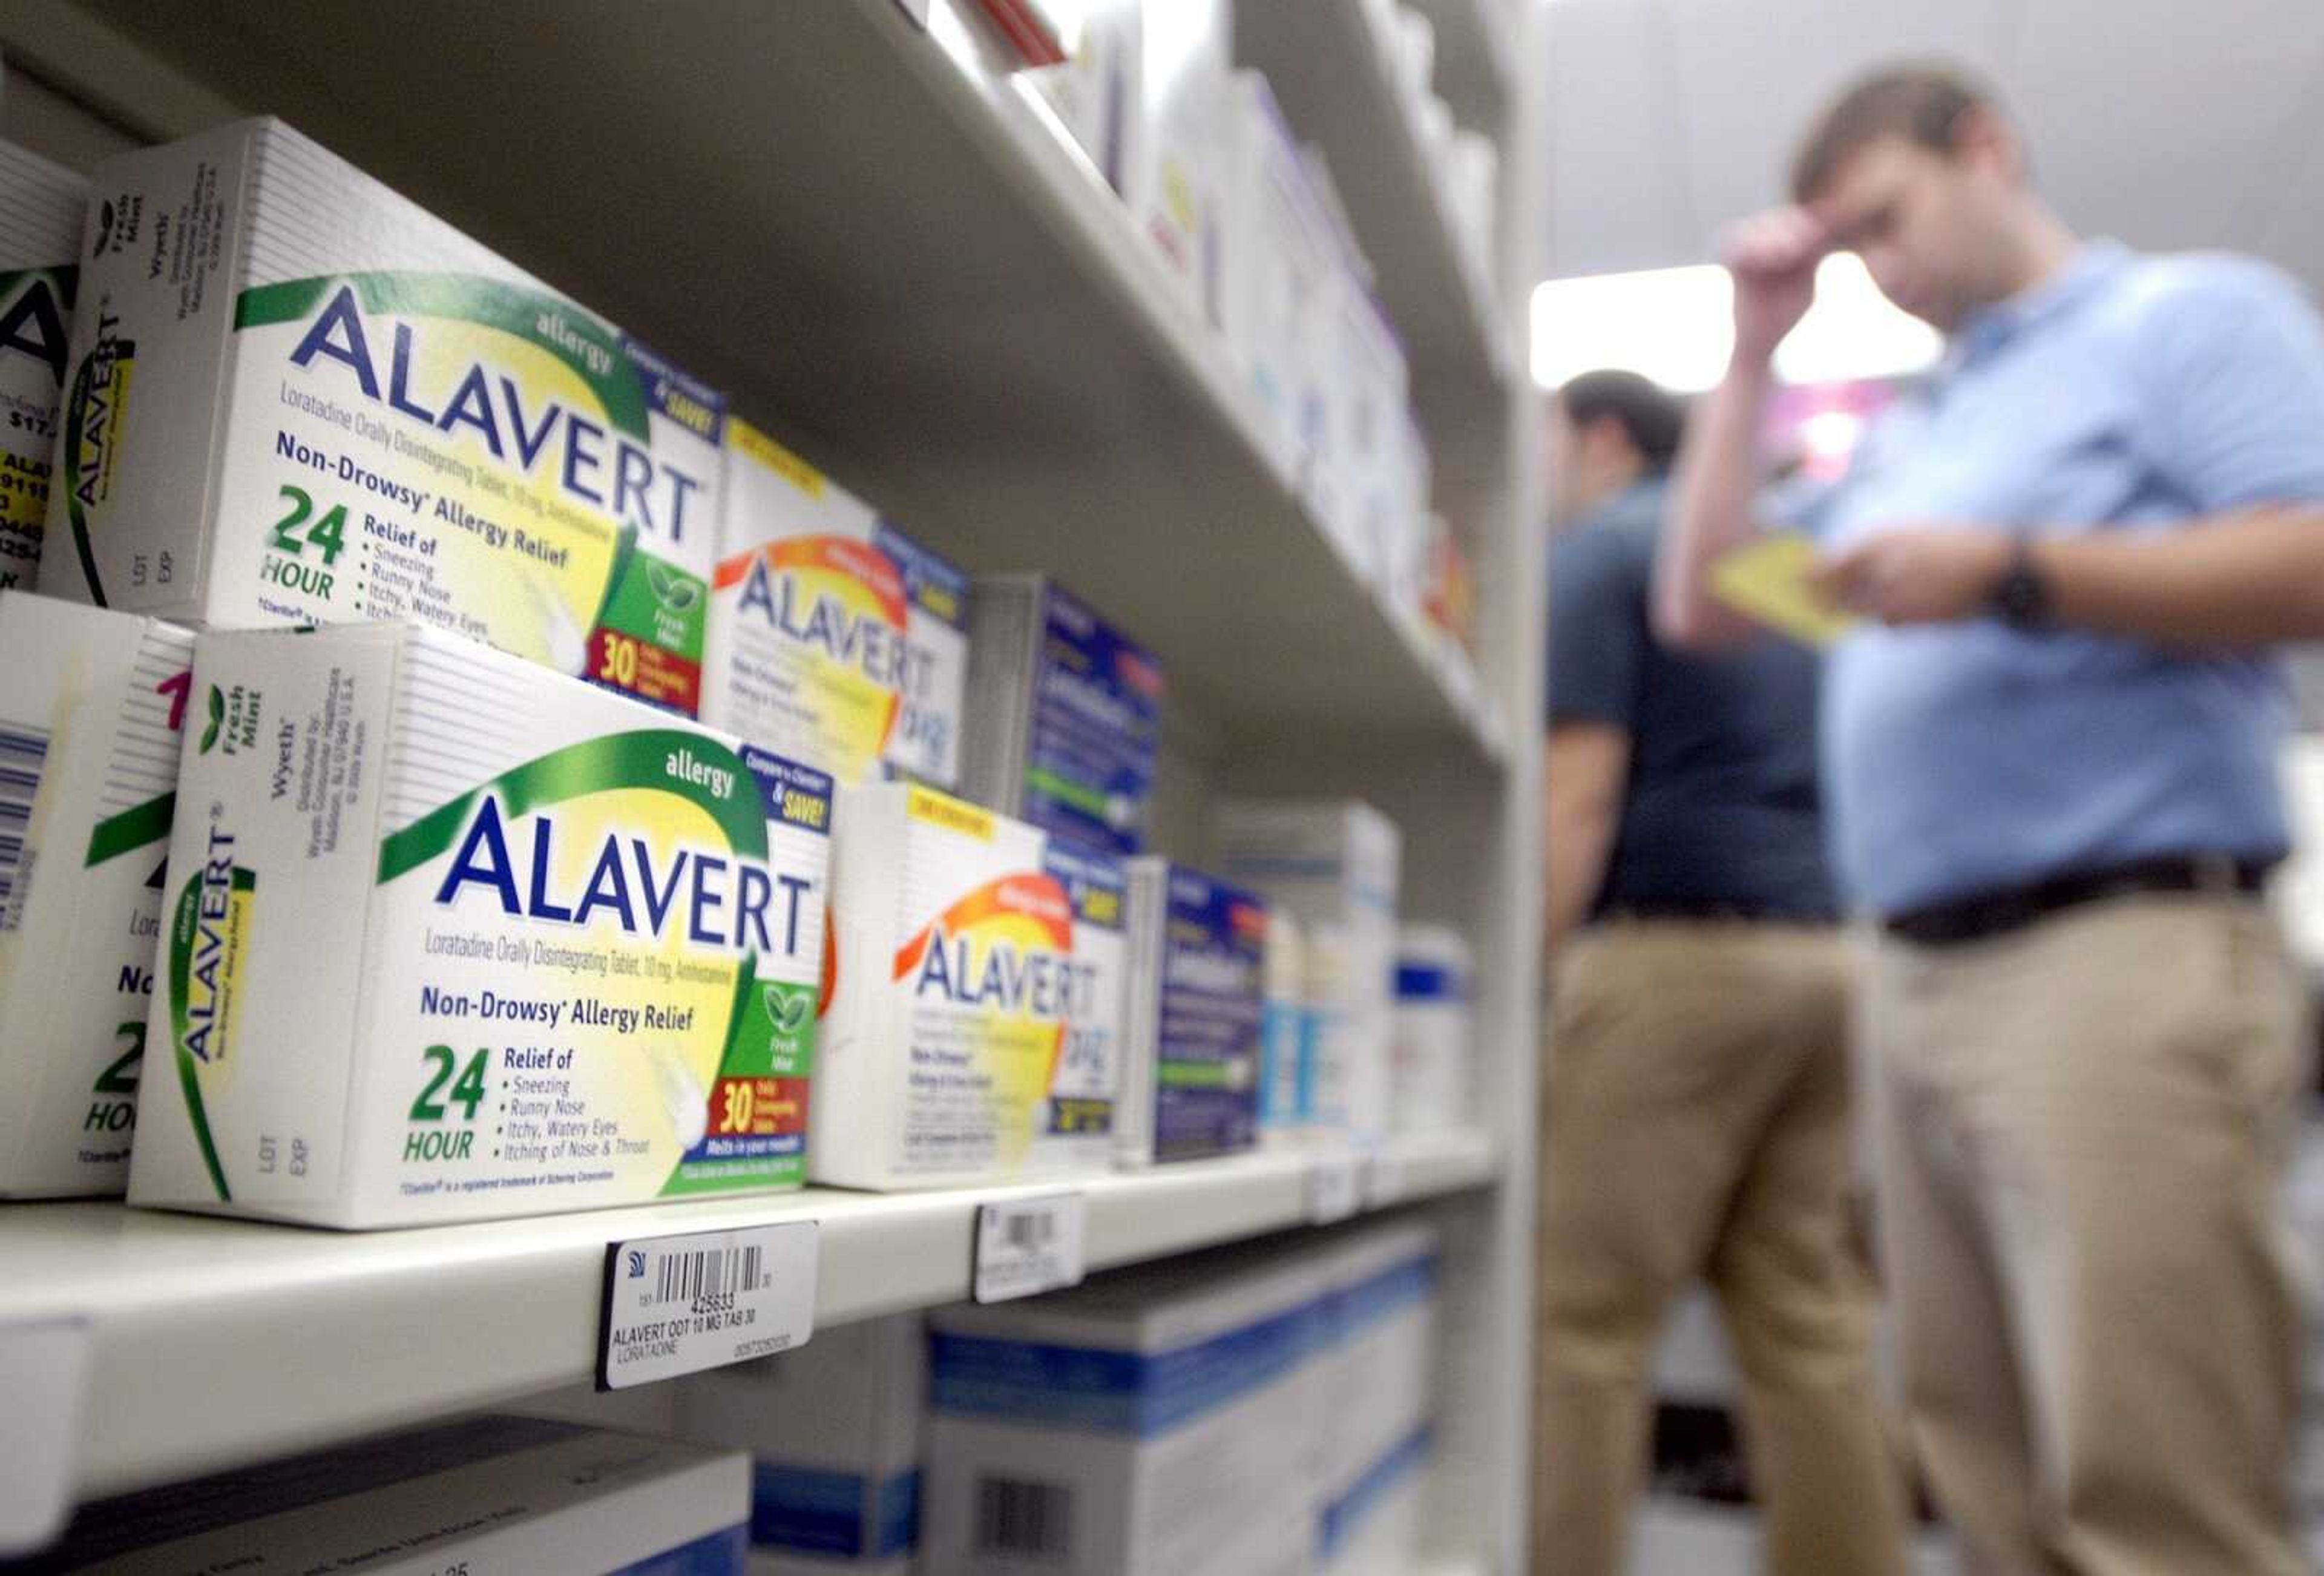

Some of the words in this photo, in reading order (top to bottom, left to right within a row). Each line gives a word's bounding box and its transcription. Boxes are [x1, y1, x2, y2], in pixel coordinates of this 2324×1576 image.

[127, 193, 144, 243] Mint
[536, 313, 613, 375] allergy
[280, 381, 352, 430] Loratadine
[355, 413, 392, 451] Orally
[395, 430, 473, 485] Disintegrating
[289, 284, 697, 542] ALAVERT
[274, 484, 348, 565] 24
[364, 513, 418, 549] Relief
[419, 538, 437, 556] of
[434, 497, 508, 548] Allergy
[513, 529, 569, 569] Relief
[260, 554, 335, 600] HOUR
[371, 561, 415, 592] Runny
[419, 579, 451, 603] Nose
[373, 543, 435, 581] Sneezing
[412, 598, 457, 626] Watery
[459, 612, 490, 634] Eyes
[738, 558, 936, 700] ALAVERT
[600, 633, 636, 685] 30
[223, 685, 244, 756] Fresh
[241, 691, 261, 749] Mint
[666, 748, 734, 799] allergy
[782, 789, 827, 828] SAVE!
[434, 795, 812, 955] ALAVERT
[425, 927, 494, 961] Loratadine
[497, 935, 531, 970] Orally
[533, 939, 608, 978] Disintegrating
[916, 927, 1097, 1016] ALAVERT
[571, 999, 640, 1034] Allergy
[643, 1004, 695, 1031] Relief
[504, 1047, 554, 1069] Relief
[557, 1048, 574, 1070] of
[407, 1045, 490, 1122] 24
[513, 1075, 571, 1098] Sneezing
[84, 1102, 137, 1131] HO
[507, 1121, 542, 1140] Itchy,
[547, 1120, 589, 1138] Watery
[592, 1118, 618, 1138] Eyes
[510, 1098, 551, 1118] Runny
[555, 1099, 585, 1115] Nose
[719, 1081, 754, 1135] 30
[257, 1135, 277, 1174] LOT
[288, 1138, 307, 1177] EXP
[402, 1130, 474, 1163] HOUR
[504, 1143, 548, 1163] Itching
[551, 1140, 566, 1159] of
[569, 1140, 599, 1158] Nose
[616, 1138, 651, 1154] Throat
[612, 1322, 666, 1346] ALAVERT
[705, 1313, 722, 1331] MG
[723, 1311, 744, 1327] TAB
